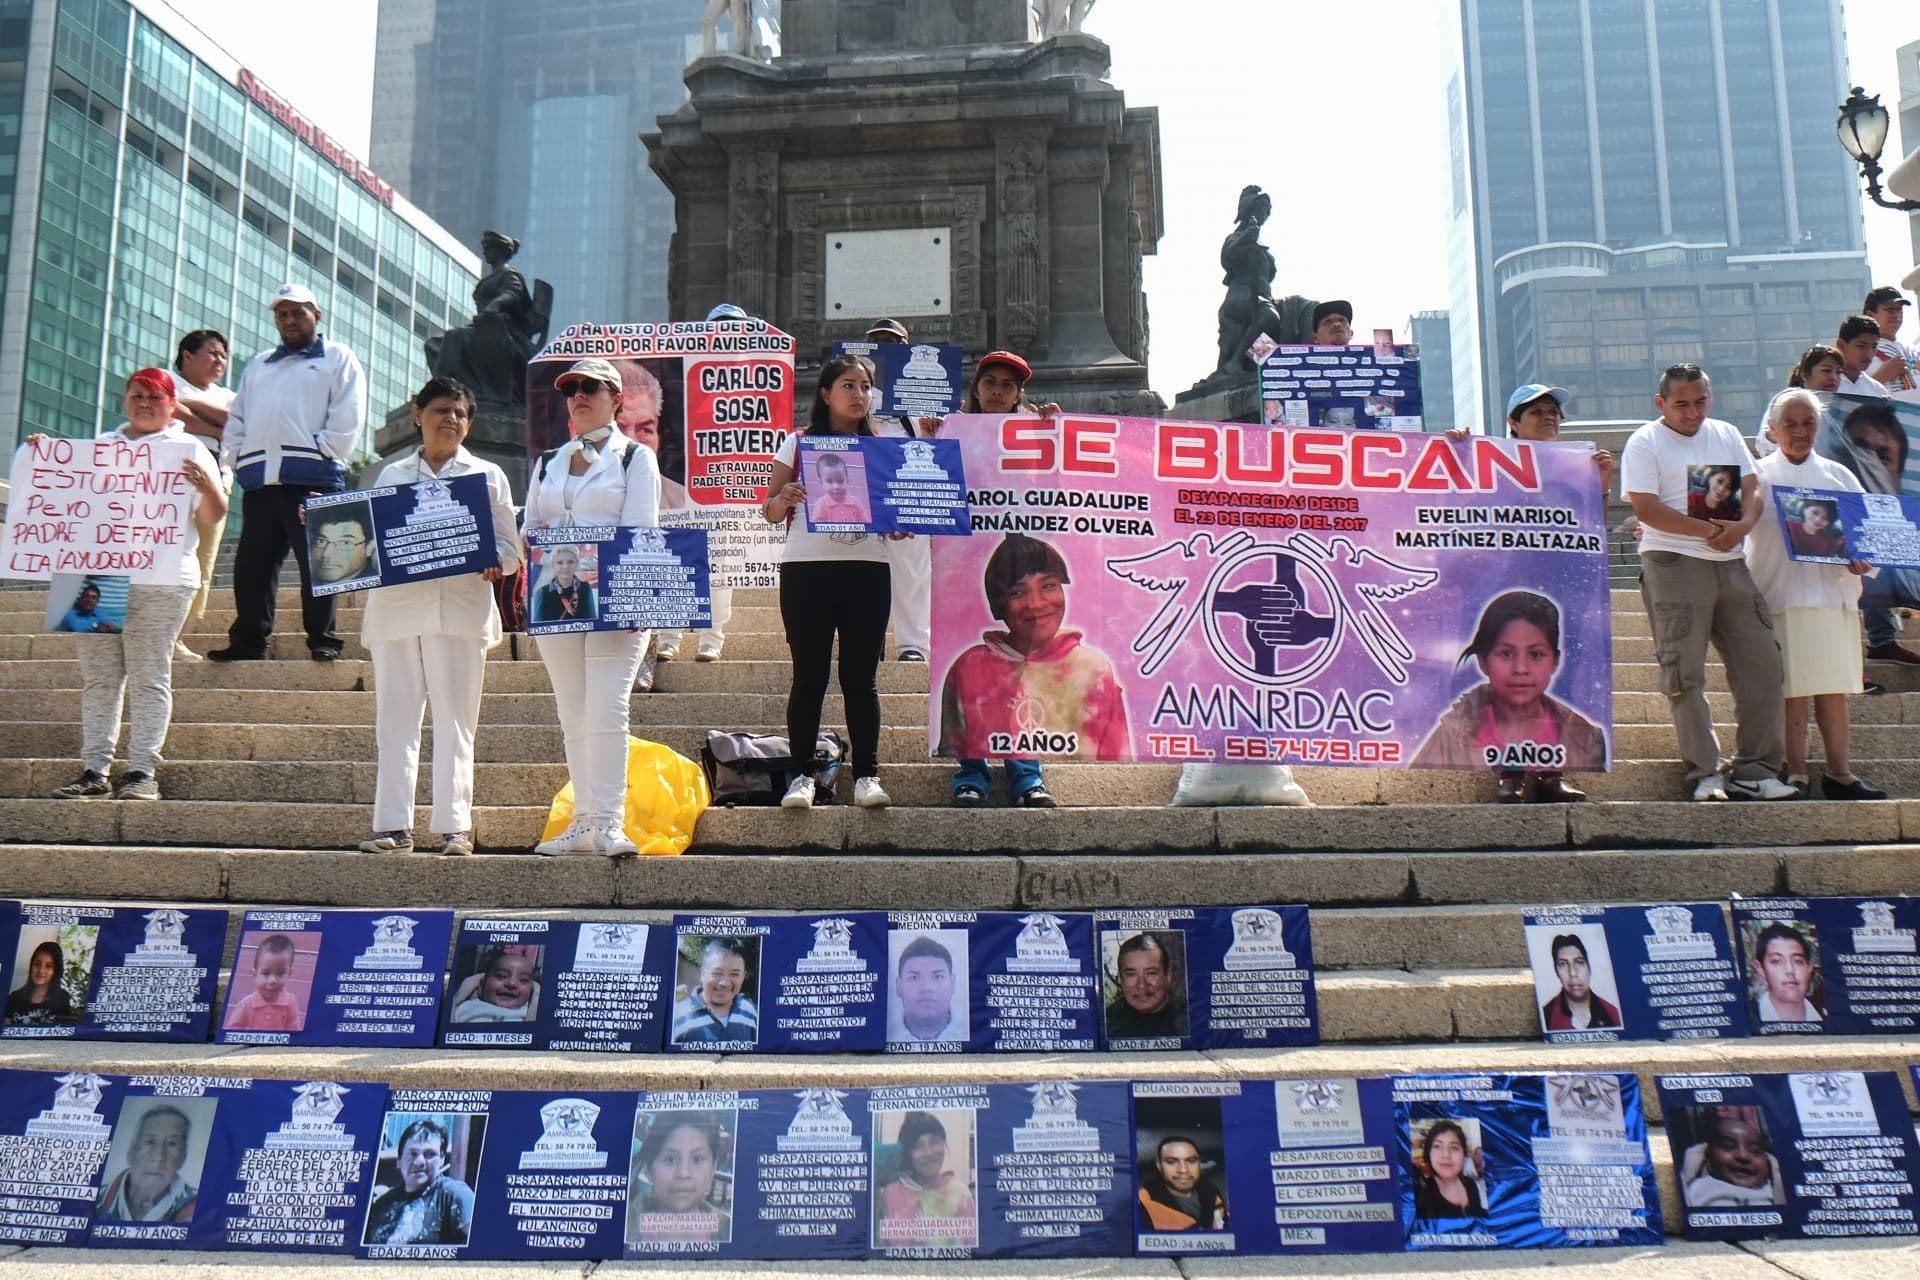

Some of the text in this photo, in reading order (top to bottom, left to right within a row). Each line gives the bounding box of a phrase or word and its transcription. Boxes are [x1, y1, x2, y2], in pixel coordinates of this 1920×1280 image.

[581, 324, 602, 336] HA
[610, 324, 653, 336] VISTO
[656, 324, 670, 336] O
[673, 322, 715, 335] SABE
[719, 321, 742, 334] DE
[543, 335, 791, 355] ARADERO POR FAVOR AVISENOS
[702, 367, 782, 392] CARLOS
[715, 398, 769, 422] SOSA
[695, 430, 787, 454] TREVERA
[31, 440, 152, 470] NO ERA
[1001, 418, 1541, 490] SE BUSCAN
[708, 463, 773, 474] EXTRAVIADO
[32, 468, 190, 496] ESTUDIANTE
[692, 476, 733, 487] PADECE
[340, 492, 365, 502] SOTO
[366, 488, 395, 498] TREJO
[725, 488, 756, 500] SENIL
[966, 490, 1149, 510] AROL GUADALUPE
[1179, 490, 1359, 511] DESAPARECIDAS DESDE
[27, 494, 90, 519] Pero
[143, 503, 177, 522] un
[694, 508, 746, 520] Metropolitana
[1175, 509, 1367, 531] EL 23 DE ENERO DEL 2017
[1418, 508, 1578, 526] EVELIN MARISOL
[971, 510, 1154, 537] RNÁNDEZ OLVERA
[12, 522, 82, 545] PADRE
[96, 523, 127, 545] DE
[438, 530, 456, 539] DEL
[729, 535, 752, 545] brazo
[1396, 529, 1600, 551] MARTÍNEZ BALTAZAR
[10, 553, 51, 573] LIA
[727, 576, 776, 586] 5113-1091
[1153, 686, 1392, 731] AMNRDAC
[990, 731, 1077, 753] 12 AÑOS
[1149, 736, 1400, 763] TEL. 56.74.79.02
[1486, 743, 1565, 765] 9 AÑOS
[23, 907, 114, 918] ESTRELLA GARCIA
[1096, 910, 1194, 920] SEVERIANO GUERRA
[486, 922, 548, 931] ALCANTARA
[1213, 983, 1303, 993] ABRIL DEL 2016 EN
[482, 1034, 493, 1043] 10
[494, 1034, 531, 1043] MESES
[129, 1077, 252, 1089] FRANCISCO SALINAS
[1665, 1077, 1752, 1089] IAN ALCANTARA
[1134, 1084, 1240, 1096] EDUARDO AVILA CID
[392, 1091, 491, 1102] MARCO ANTONIO
[1696, 1091, 1723, 1103] NERI
[393, 1100, 489, 1112] GUTIERREZ RUIZ
[1370, 1150, 1384, 1160] DE
[50, 1162, 98, 1174] ZAPATA
[50, 1173, 90, 1184] SANTA
[1275, 1167, 1386, 1182] MARZO DEL 2017 EN
[266, 1182, 298, 1192] LOTE
[610, 1175, 627, 1187] DE
[507, 1188, 625, 1201] MARZO DEL 2018 EN
[1278, 1185, 1364, 1200] EL CENTRO DE
[228, 1193, 356, 1206] AMPLIACION CUIDAD
[16, 1201, 61, 1212] TIRADO
[511, 1204, 611, 1218] EL MUNICIPIO DE
[1280, 1208, 1362, 1220] TEPOZOTLAN
[1741, 1214, 1781, 1225] MESES
[519, 1220, 597, 1233] TULANCINGO
[134, 1227, 149, 1239] 70
[1285, 1229, 1317, 1240] MEX.
